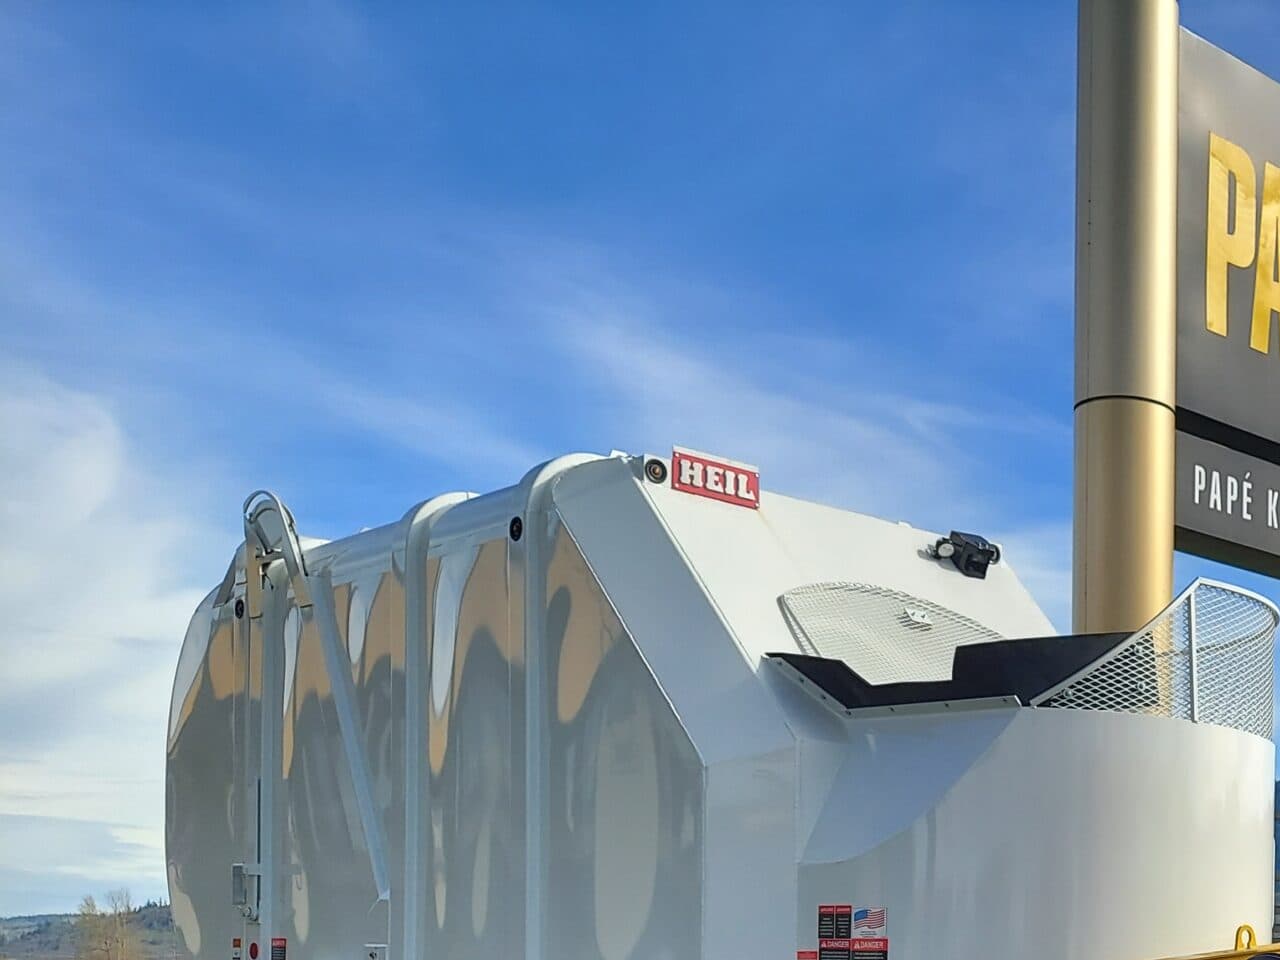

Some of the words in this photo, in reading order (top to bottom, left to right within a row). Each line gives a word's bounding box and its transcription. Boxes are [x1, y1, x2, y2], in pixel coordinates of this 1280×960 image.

[679, 459, 756, 500] HEIL
[1193, 464, 1253, 521] PAPÉ
[860, 941, 884, 949] DANGER
